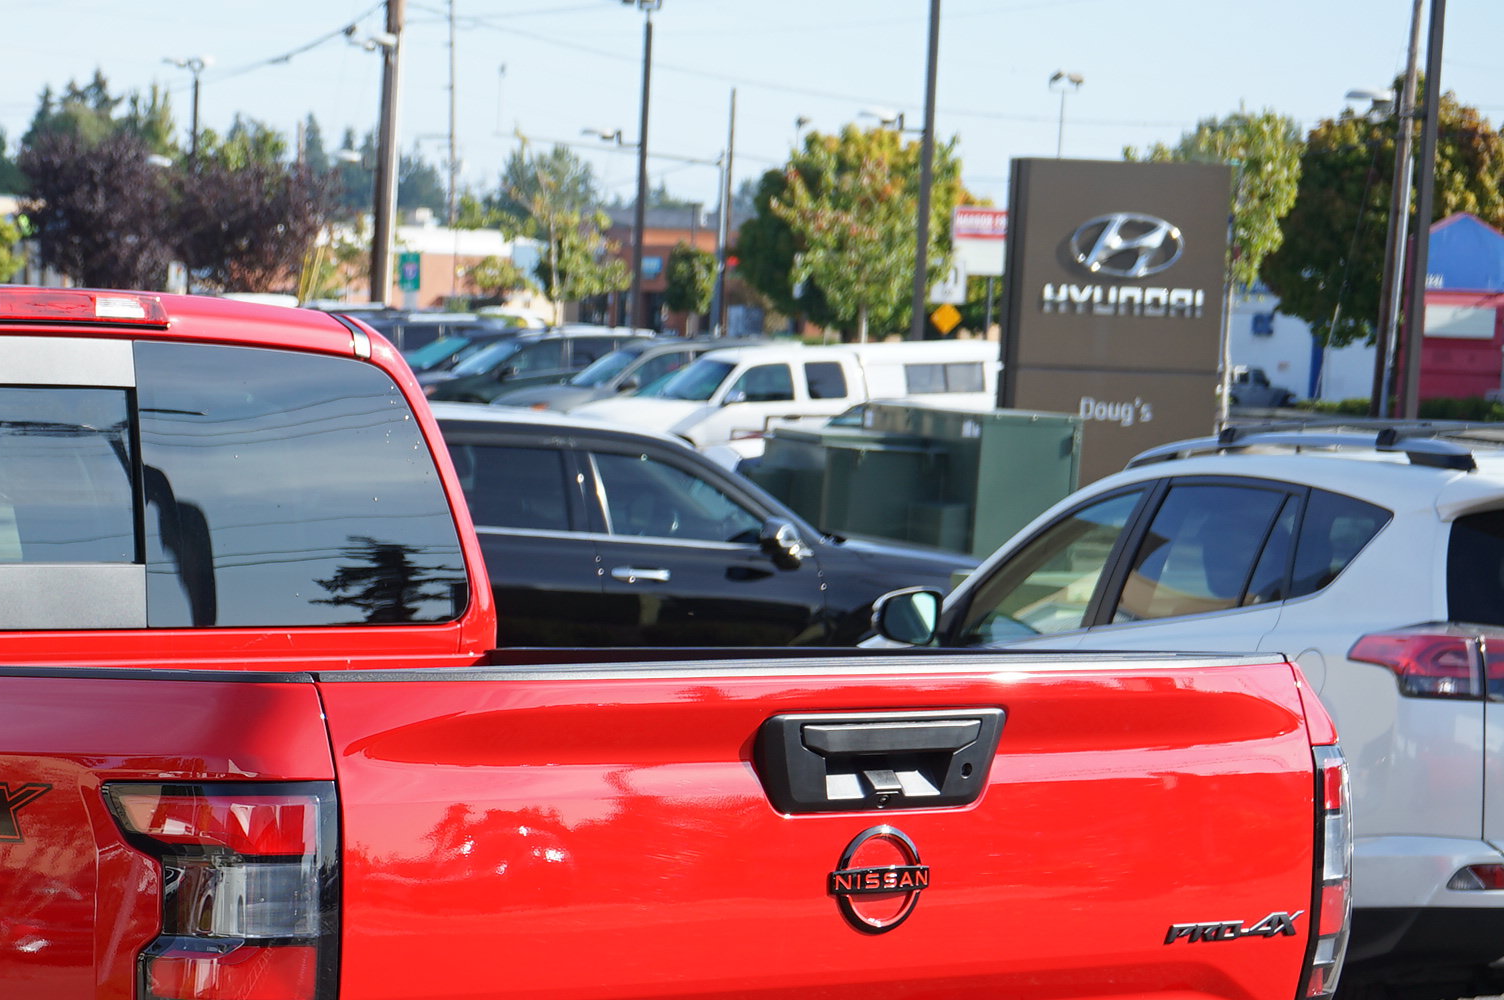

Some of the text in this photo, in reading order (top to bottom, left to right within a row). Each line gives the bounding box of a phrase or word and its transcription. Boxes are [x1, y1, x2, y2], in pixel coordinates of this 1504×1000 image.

[1043, 283, 1205, 317] HYUNDAI
[1080, 397, 1153, 426] Doug's
[835, 870, 928, 890] NISSAN
[1163, 909, 1305, 945] PRO-4X
